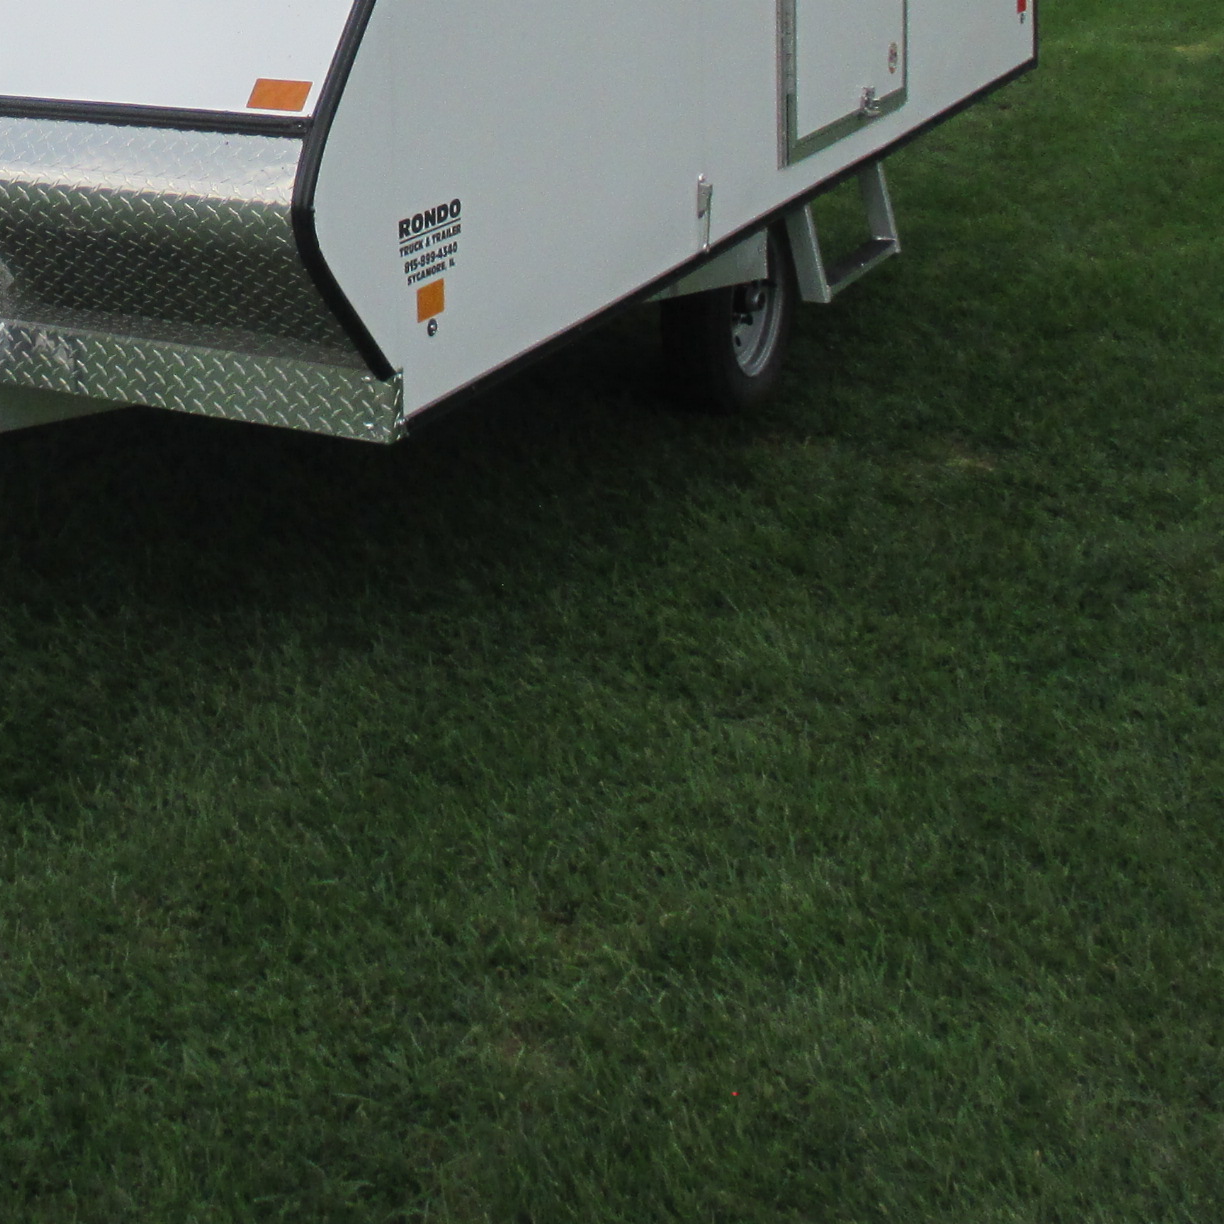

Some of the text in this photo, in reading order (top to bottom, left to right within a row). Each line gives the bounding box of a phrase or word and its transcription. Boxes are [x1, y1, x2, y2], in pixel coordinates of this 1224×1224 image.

[398, 198, 461, 239] RONDO
[399, 239, 424, 257] TRUCK
[432, 224, 462, 244] TRAILER
